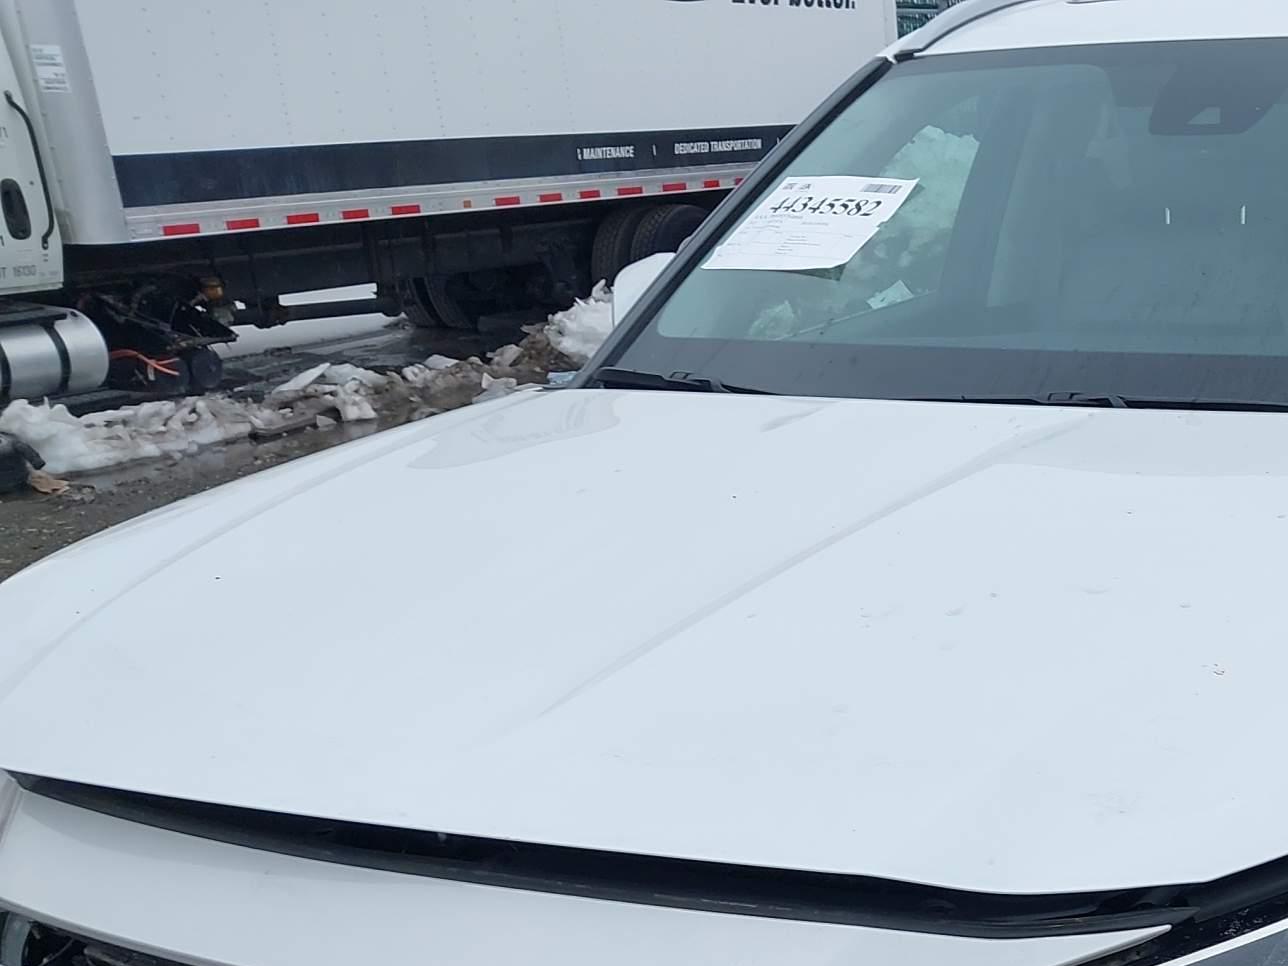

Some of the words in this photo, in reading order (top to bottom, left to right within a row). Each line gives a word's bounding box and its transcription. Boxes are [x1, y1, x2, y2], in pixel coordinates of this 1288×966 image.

[583, 146, 634, 160] MAINTENANCE
[674, 142, 709, 155] DEDICATED
[710, 139, 762, 152] TRANSPORTATION
[769, 197, 882, 216] 44345582
